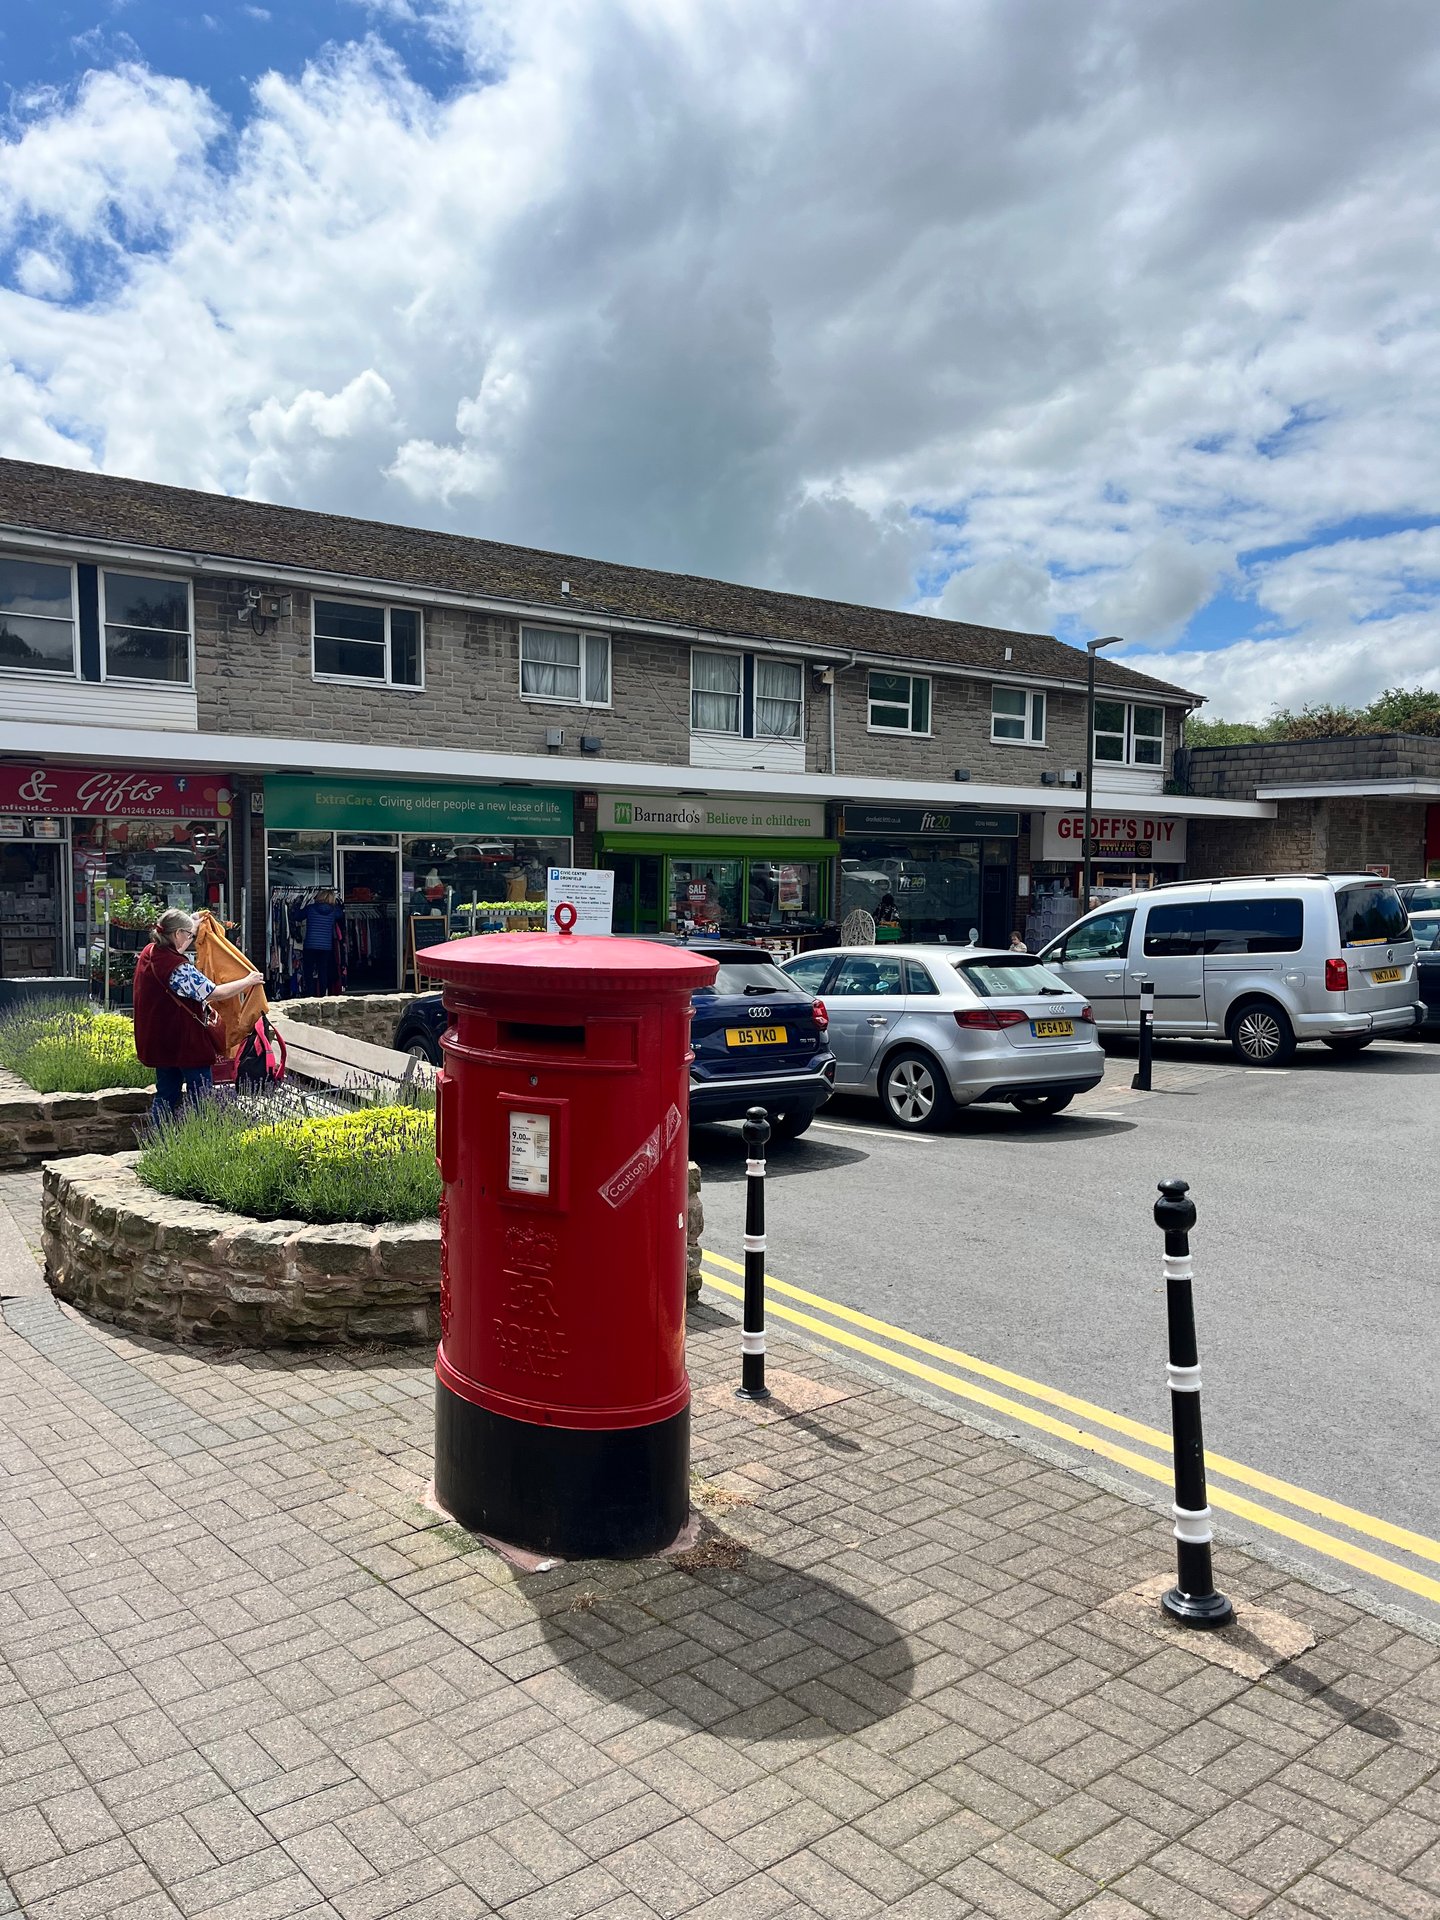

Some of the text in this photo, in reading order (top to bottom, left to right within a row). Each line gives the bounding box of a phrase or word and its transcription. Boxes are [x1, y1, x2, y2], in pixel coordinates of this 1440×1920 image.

[18, 770, 163, 812] & Gifts
[122, 807, 175, 816] 01246 412436
[315, 793, 562, 814] ExtraCare. Giving older people a new lease of life.
[634, 806, 811, 827] Barnardo's Believe in children
[920, 812, 951, 831] fit20
[1057, 817, 1175, 841] GEOFF'S DIY
[688, 884, 707, 894] SALE
[738, 1029, 777, 1043] D5 YKO
[1037, 1020, 1073, 1034] AF64 DJK
[609, 1161, 645, 1198] Caution
